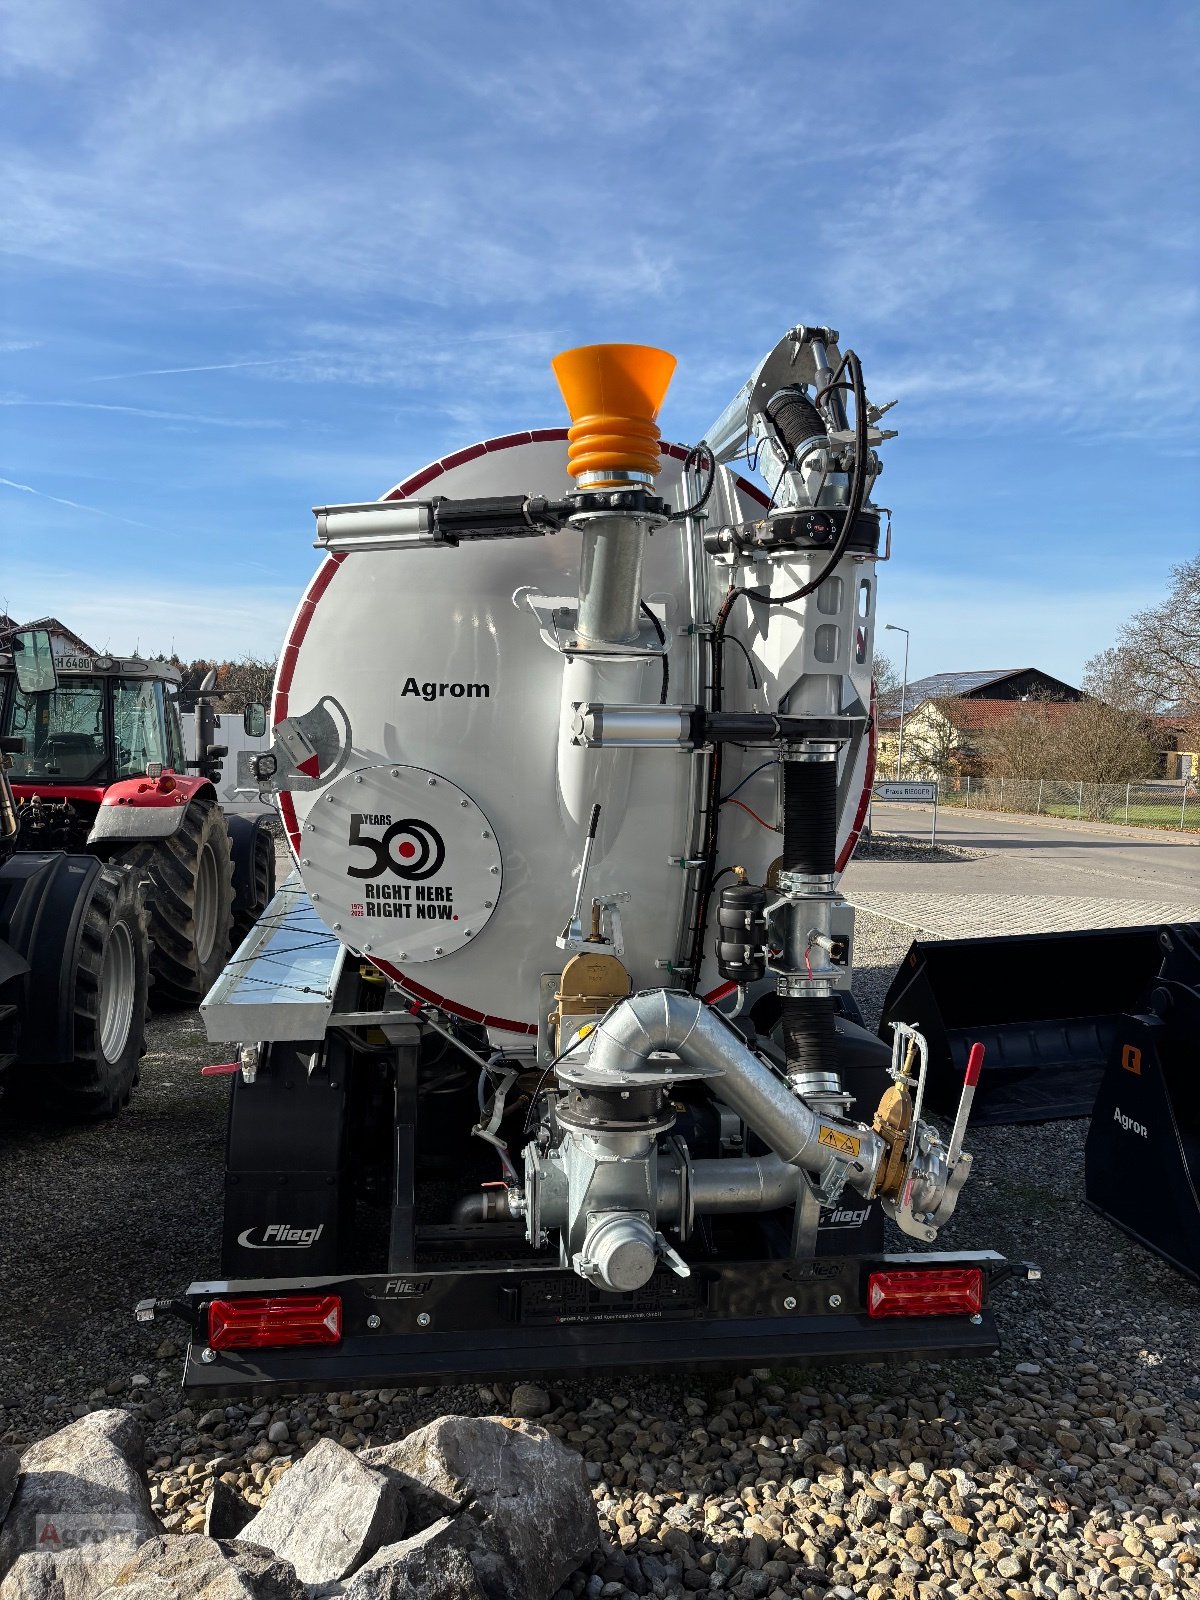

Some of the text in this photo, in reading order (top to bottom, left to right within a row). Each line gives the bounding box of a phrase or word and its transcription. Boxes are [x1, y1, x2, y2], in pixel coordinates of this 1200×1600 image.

[65, 658, 90, 669] 6480
[401, 677, 490, 702] Agrom
[363, 813, 392, 826] YEARS
[346, 813, 446, 881] 50
[364, 883, 453, 903] RIGHT HERE
[366, 901, 459, 921] RIGHT NOW.
[262, 1223, 325, 1246] Fliegl
[383, 1278, 434, 1296] Fliegl
